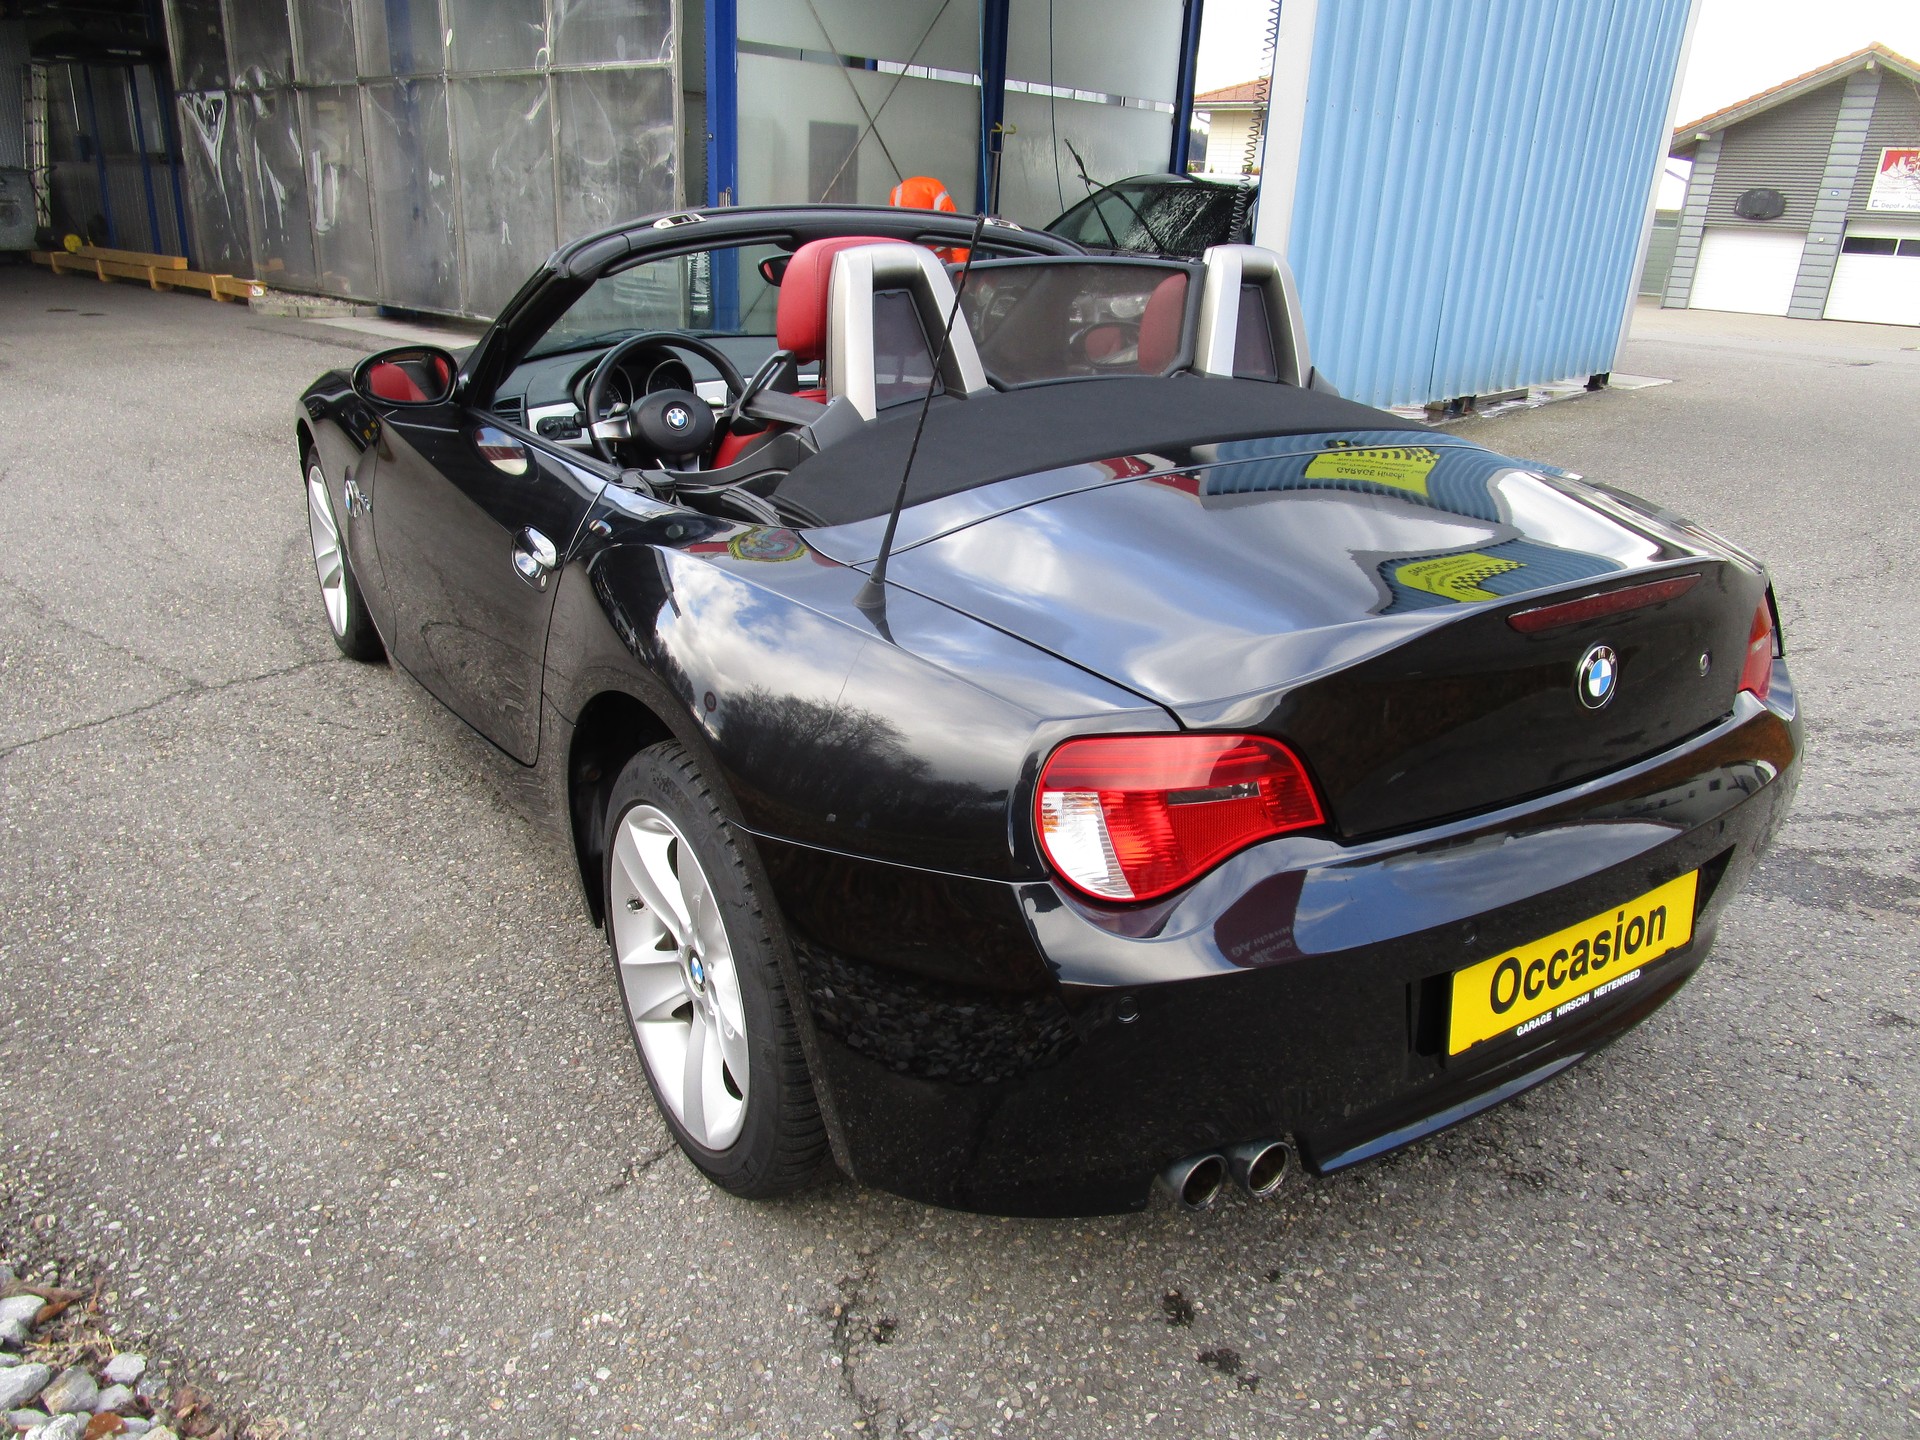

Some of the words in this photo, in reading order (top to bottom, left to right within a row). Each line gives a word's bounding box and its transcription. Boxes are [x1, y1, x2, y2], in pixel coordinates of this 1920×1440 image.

[1490, 904, 1667, 1015] Occasion
[1516, 1011, 1552, 1037] GARAGE
[1556, 992, 1590, 1017] HIRSCHI
[1593, 968, 1641, 999] HEITENRIED
